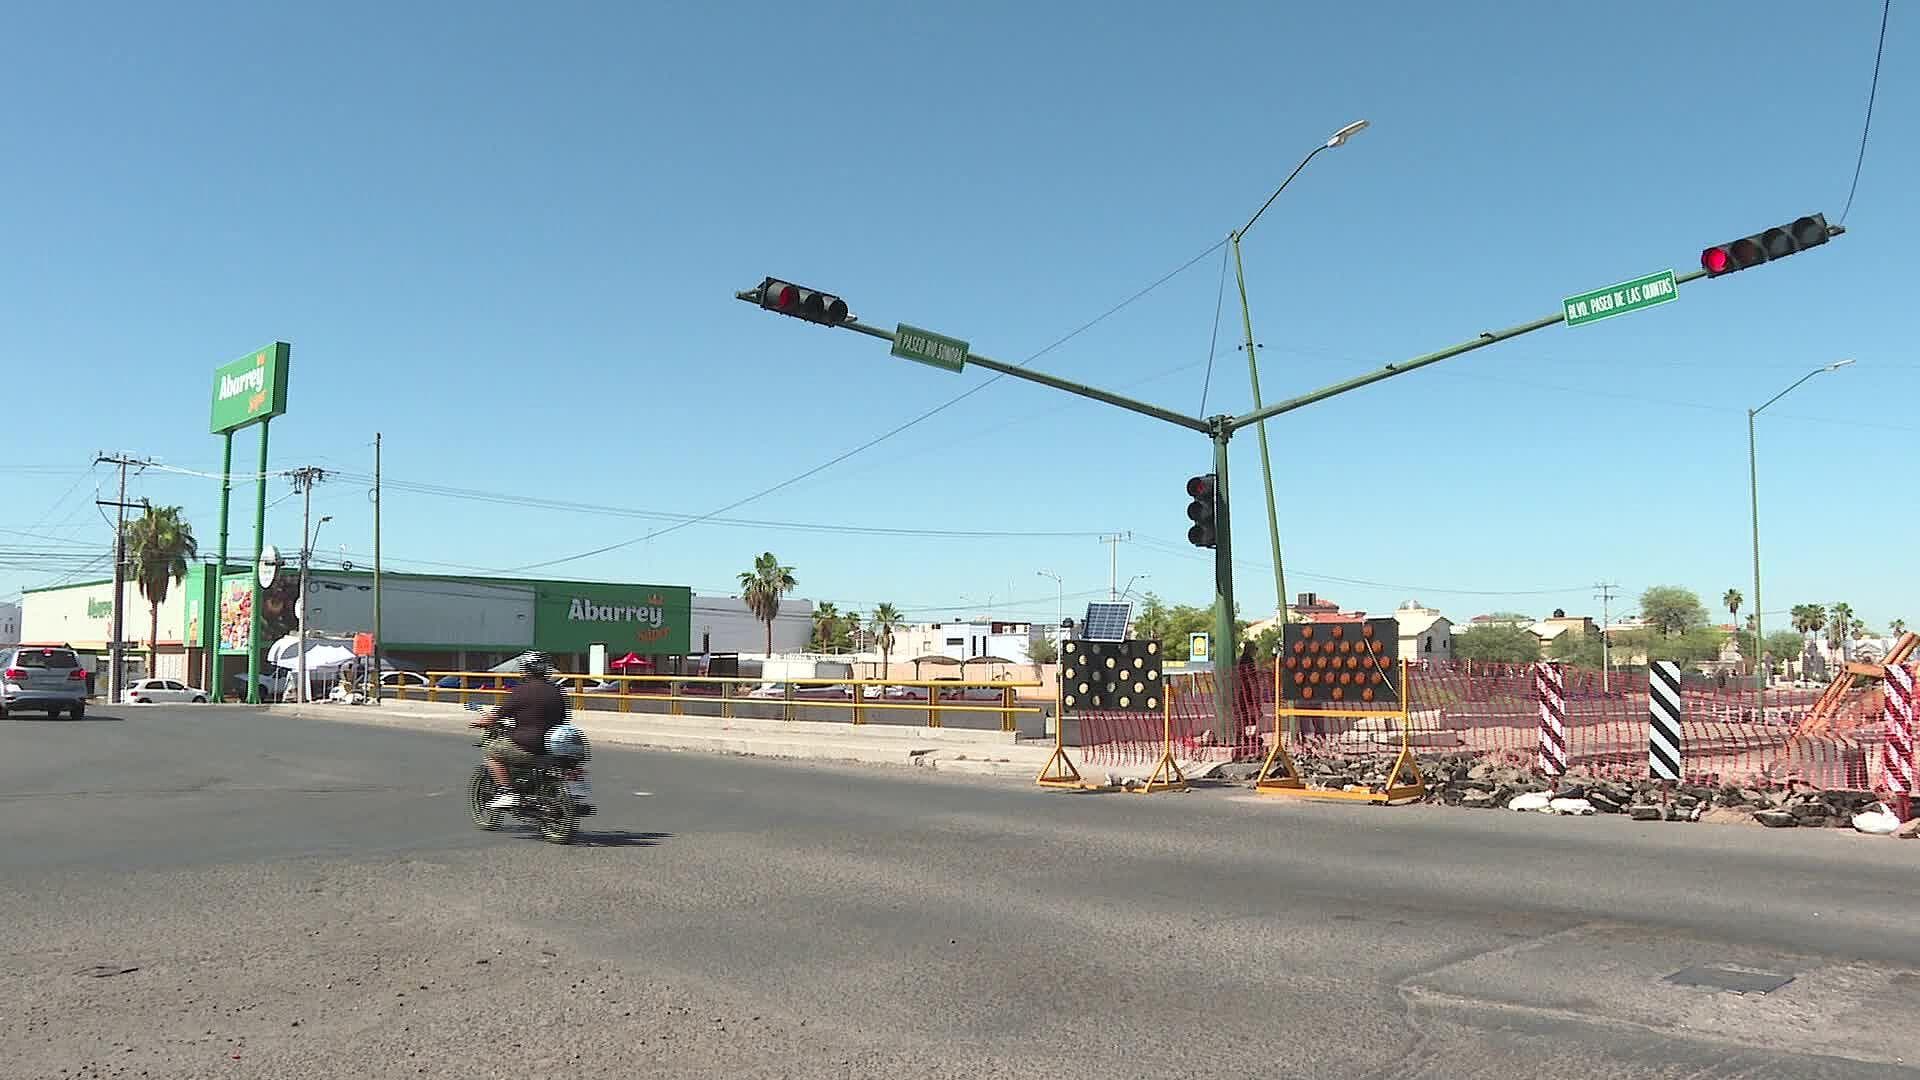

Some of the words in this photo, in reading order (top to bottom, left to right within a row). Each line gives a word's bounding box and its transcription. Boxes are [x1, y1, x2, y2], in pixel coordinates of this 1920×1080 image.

[1590, 293, 1614, 314] PASEO
[1614, 290, 1626, 307] DE
[1626, 286, 1642, 304] LAS
[1642, 278, 1673, 300] QUINTAS
[902, 334, 926, 354] PASEO
[218, 366, 264, 401] Abarrey
[568, 598, 664, 629] Abarrey
